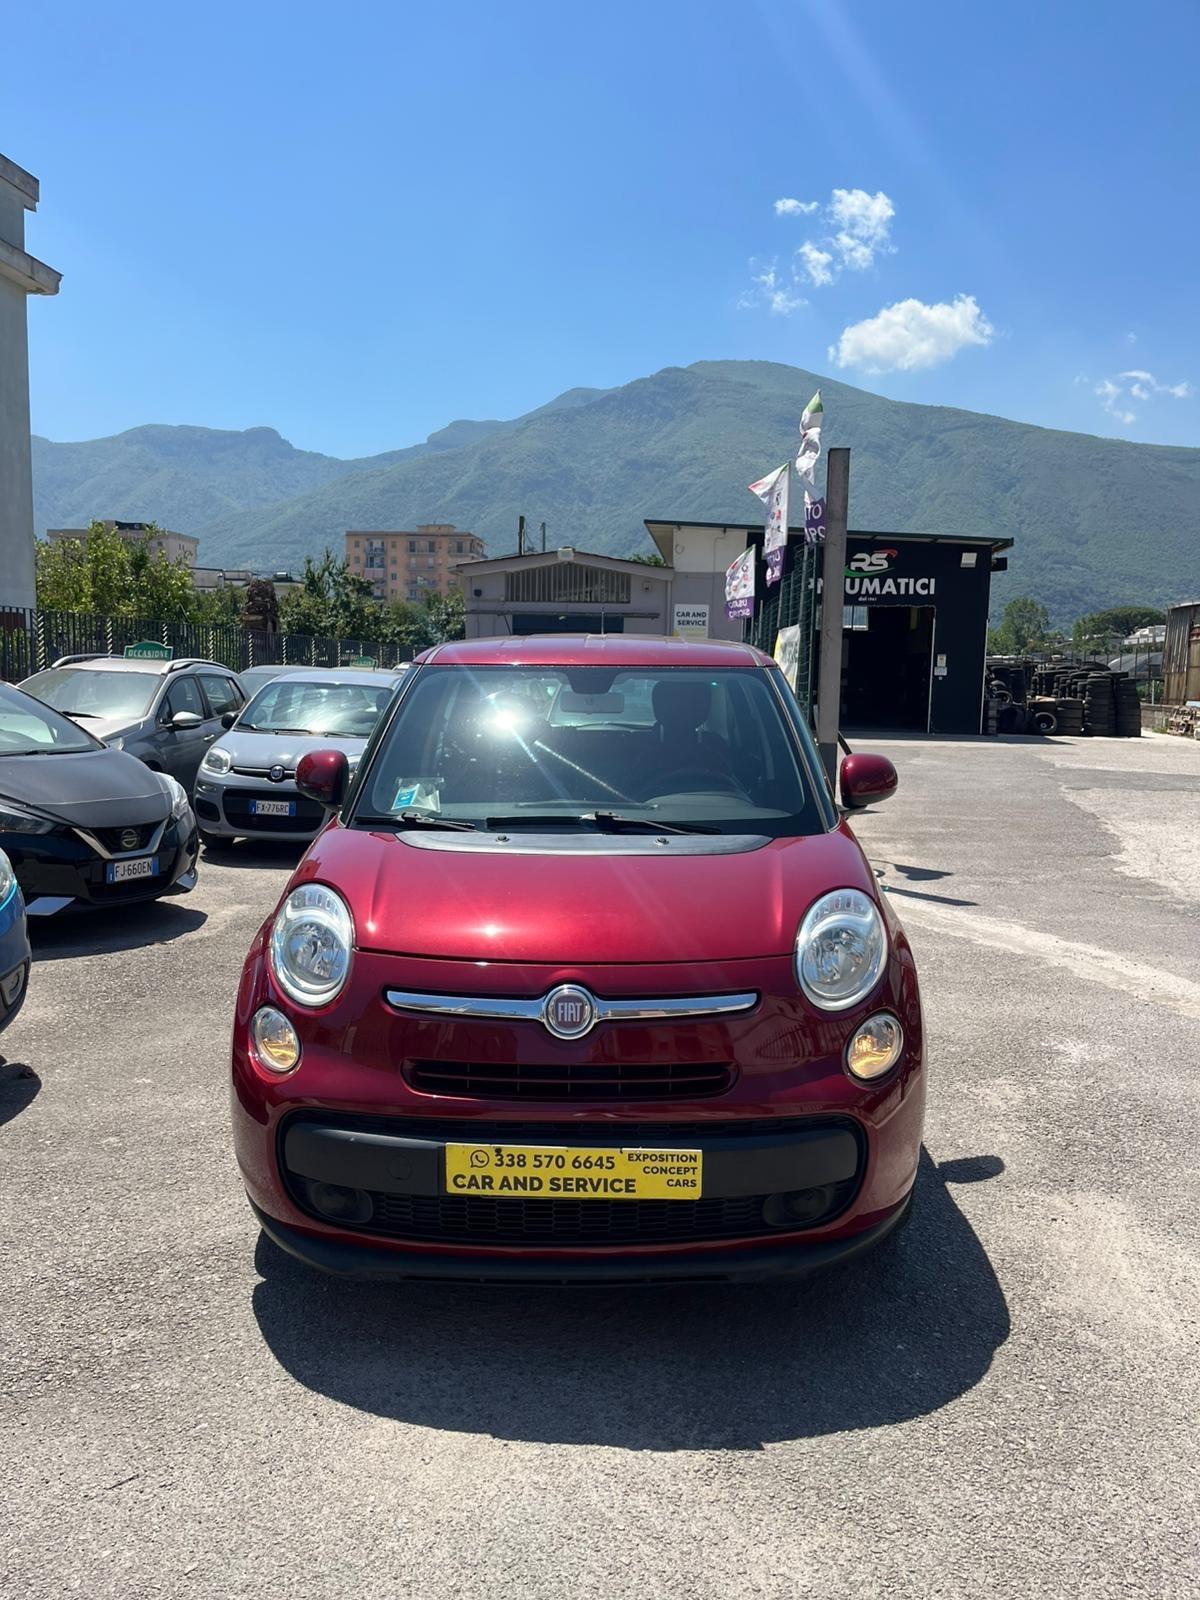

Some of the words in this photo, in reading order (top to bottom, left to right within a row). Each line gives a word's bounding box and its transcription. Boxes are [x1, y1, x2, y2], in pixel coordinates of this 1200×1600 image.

[850, 553, 889, 571] RS
[807, 578, 936, 595] UMATICI
[128, 649, 169, 658] OCCASIONE
[558, 1002, 582, 1022] FIAT
[494, 1152, 527, 1168] 338
[533, 1154, 566, 1169] 570
[571, 1155, 616, 1170] 6645
[627, 1153, 698, 1163] EXPOSITION
[642, 1165, 698, 1175] CONCEPT
[452, 1174, 494, 1190] CAR
[498, 1175, 543, 1192] AND
[549, 1177, 636, 1193] SERVICE
[666, 1178, 697, 1188] CARS
